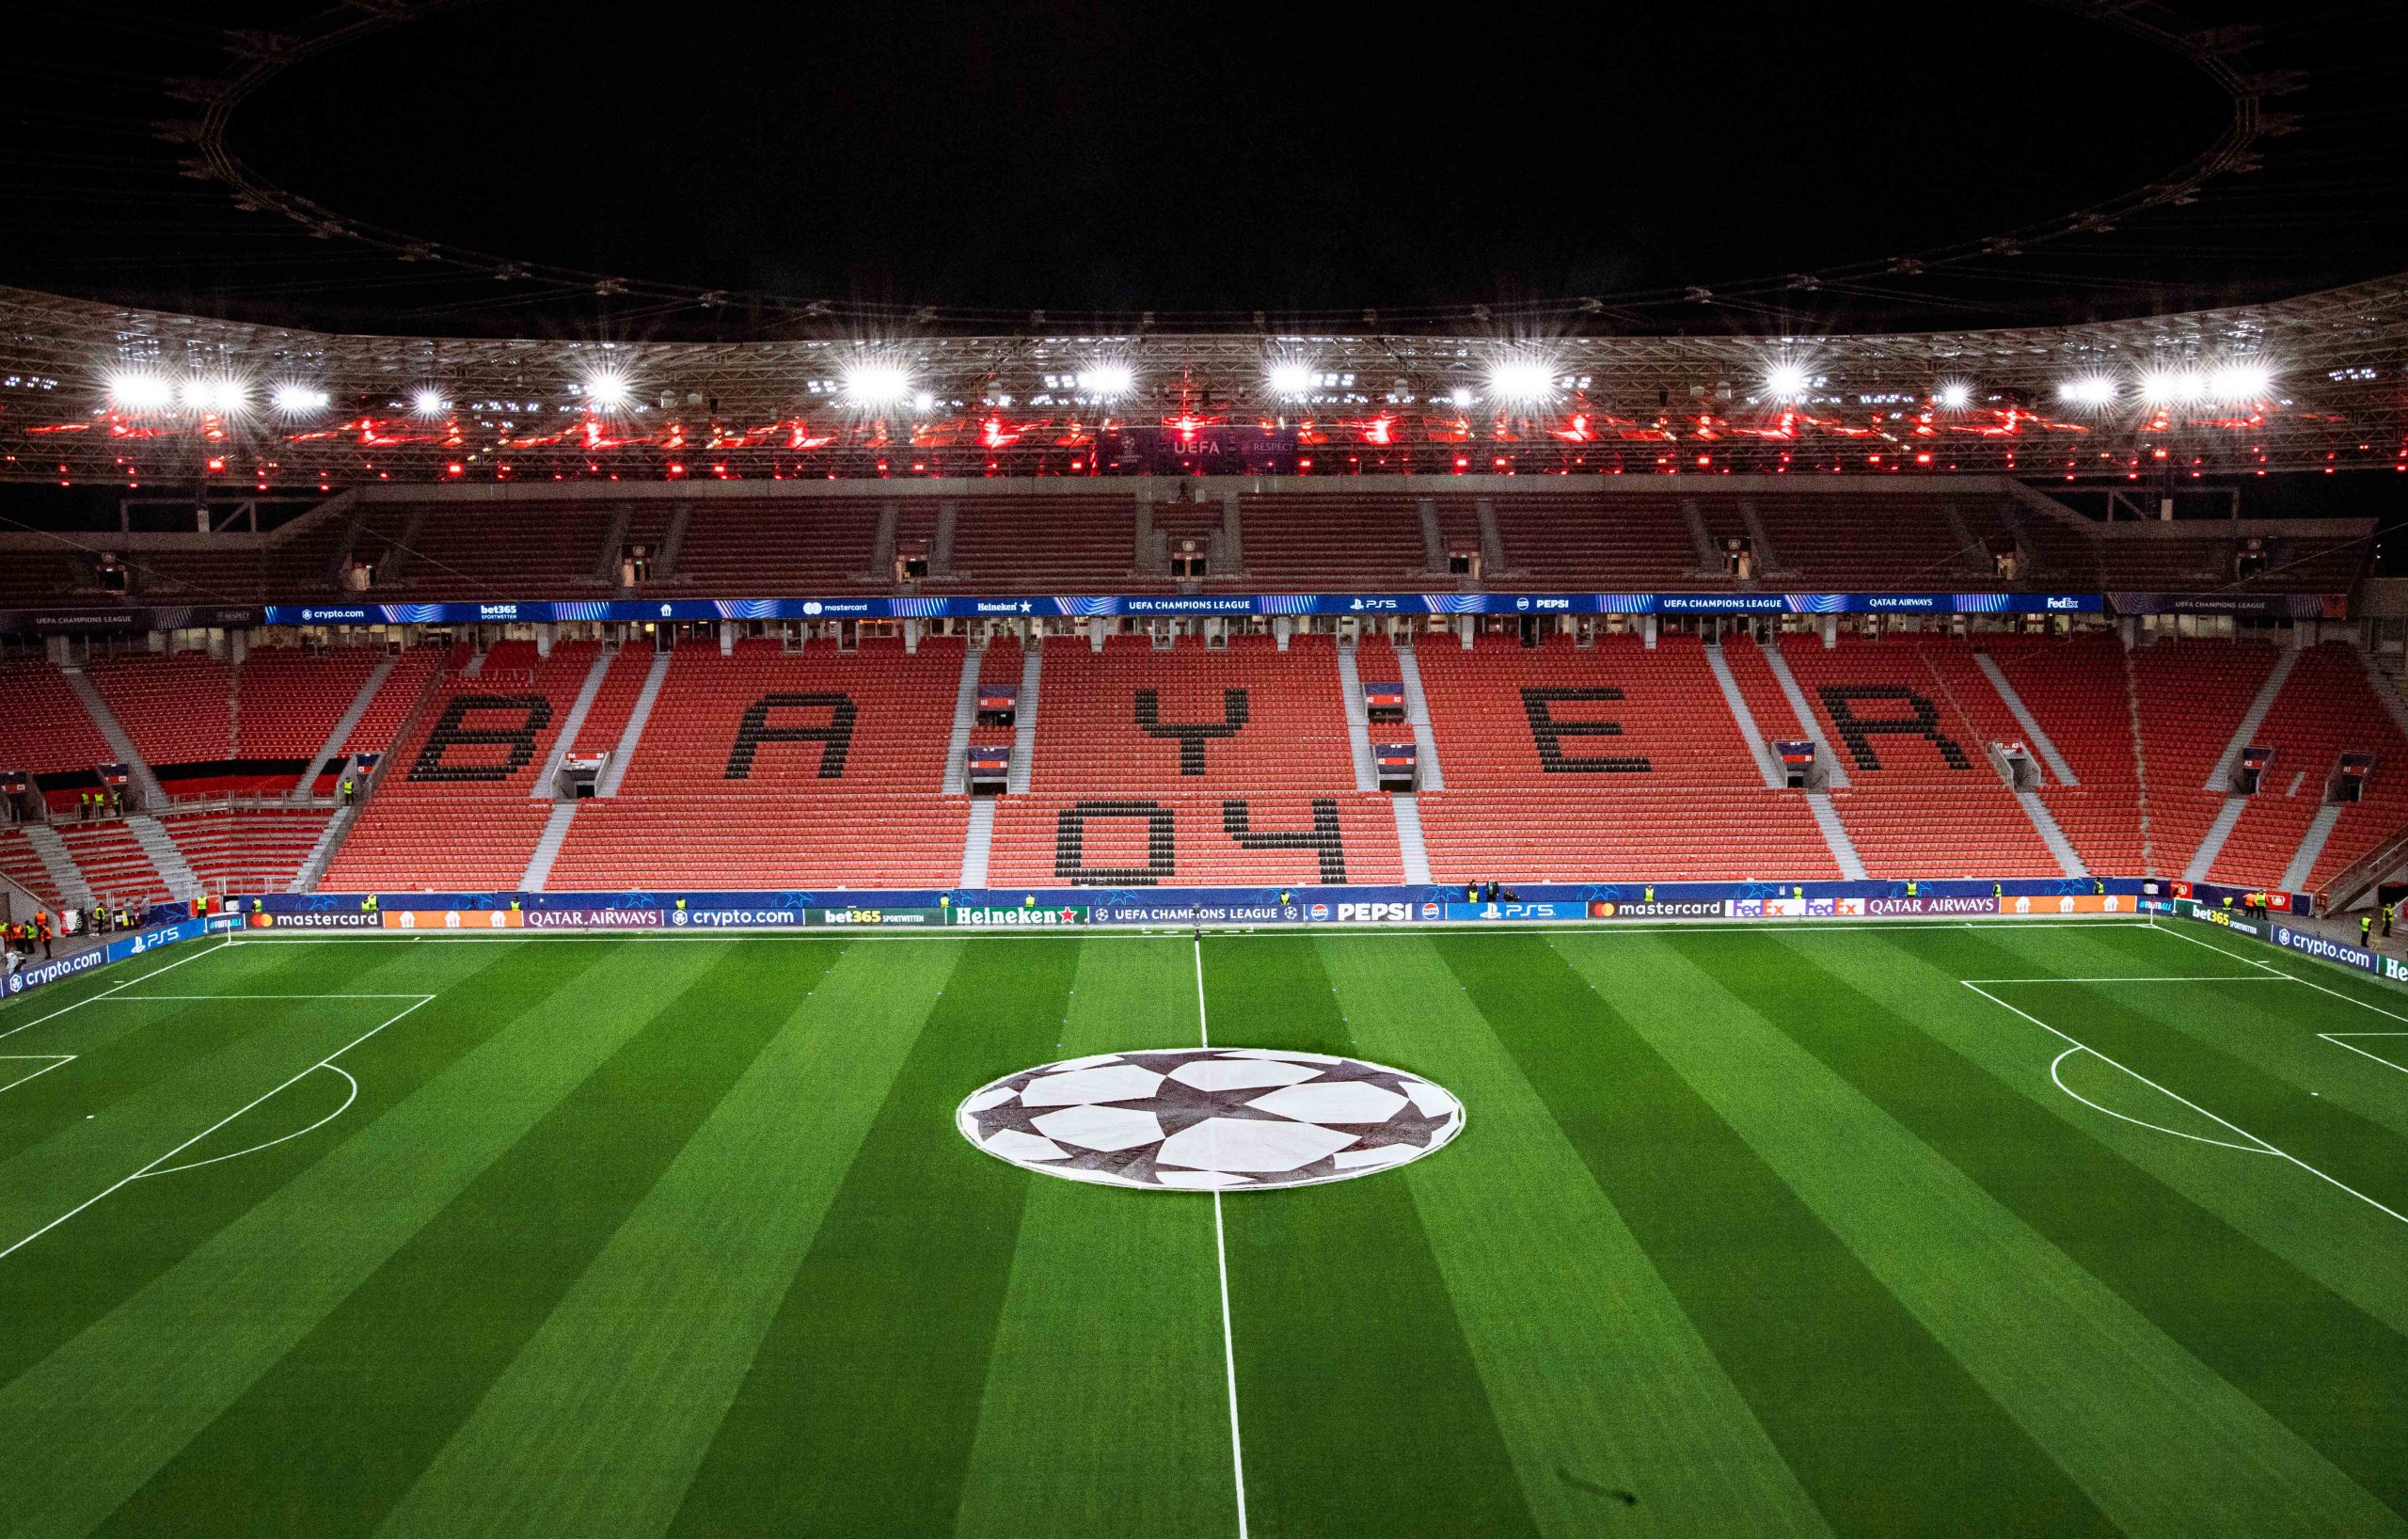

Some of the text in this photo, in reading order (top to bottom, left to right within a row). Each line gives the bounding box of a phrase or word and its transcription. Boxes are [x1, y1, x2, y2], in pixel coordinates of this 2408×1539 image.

[1175, 441, 1293, 454] UEFA RESPECT
[481, 605, 516, 613] bet365
[977, 602, 1017, 611] Heineken
[1129, 600, 1250, 610] UEFA CHAMPIONS LEAGUE
[1366, 600, 1398, 609] PS5
[1536, 599, 1569, 608] PEPSI
[1664, 599, 1782, 608] UEFA CHAMPIONS LEAGUE
[1869, 598, 1897, 607] QATAR
[2047, 597, 2079, 609] FedEx
[314, 609, 364, 619] crypto.com
[1338, 903, 1413, 921] PEPSI
[1506, 905, 1554, 917] PS5
[1619, 901, 1720, 915] mastercard
[1733, 899, 1857, 916] FedEx FedEx
[1870, 898, 1994, 914] QATAR AIRWAYS
[277, 912, 378, 927] mastercard
[529, 911, 657, 927] QATAR AIRWAYS
[692, 910, 795, 926] crypto.com
[825, 909, 925, 923] bet365 SPORTWETTEN
[956, 907, 1057, 925] Heineken
[1115, 909, 1149, 921] UEFA
[1230, 908, 1277, 919] LEAGUE
[2193, 904, 2258, 935] bet365 SPORTWETTEN
[148, 927, 180, 944] PS5
[2293, 934, 2370, 968] crypto.com
[25, 949, 102, 986] crypto.com
